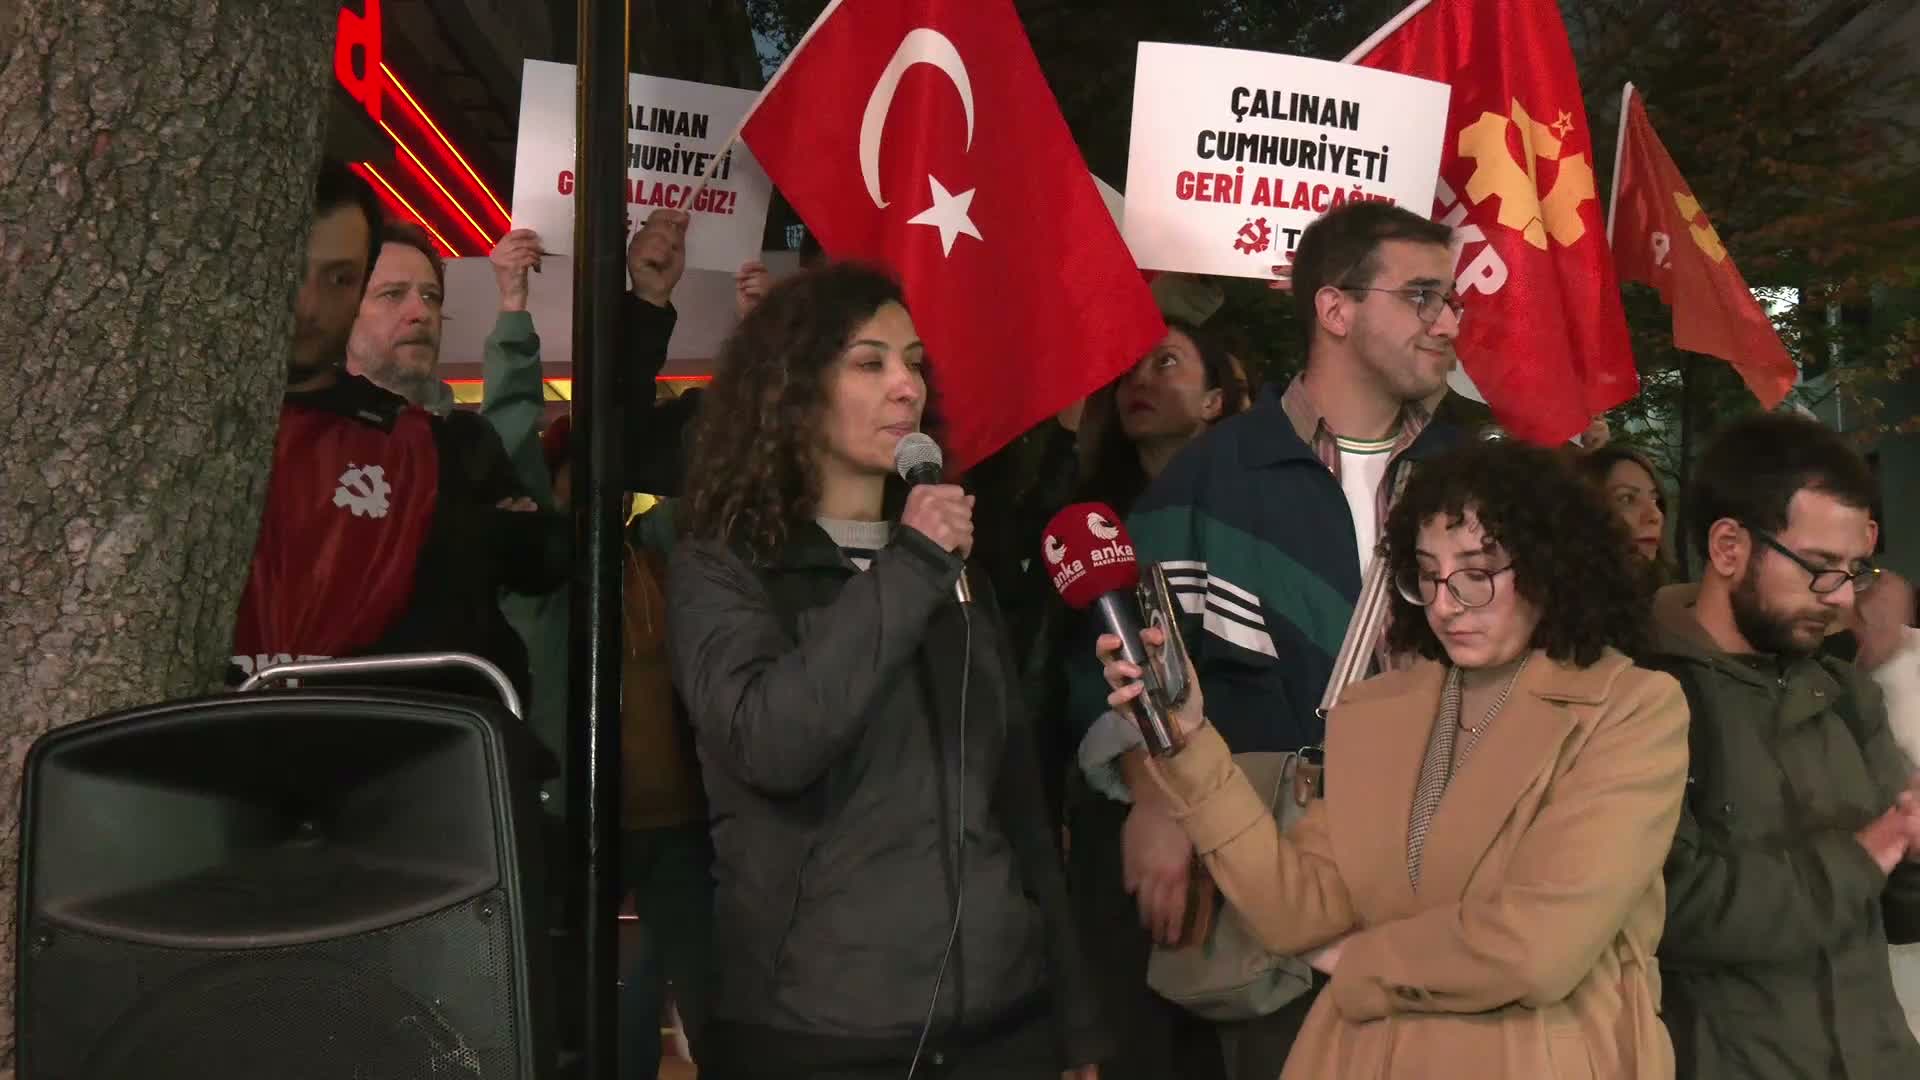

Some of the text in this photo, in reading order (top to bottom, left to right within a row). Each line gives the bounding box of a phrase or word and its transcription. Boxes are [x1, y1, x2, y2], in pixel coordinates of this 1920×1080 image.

[1231, 86, 1360, 131] ÇALINAN
[628, 142, 732, 180] HURİYETİ
[1196, 130, 1389, 183] CUMHURİYETİ
[1176, 166, 1244, 204] GERİ
[1090, 540, 1134, 561] anka
[1053, 560, 1084, 589] anka
